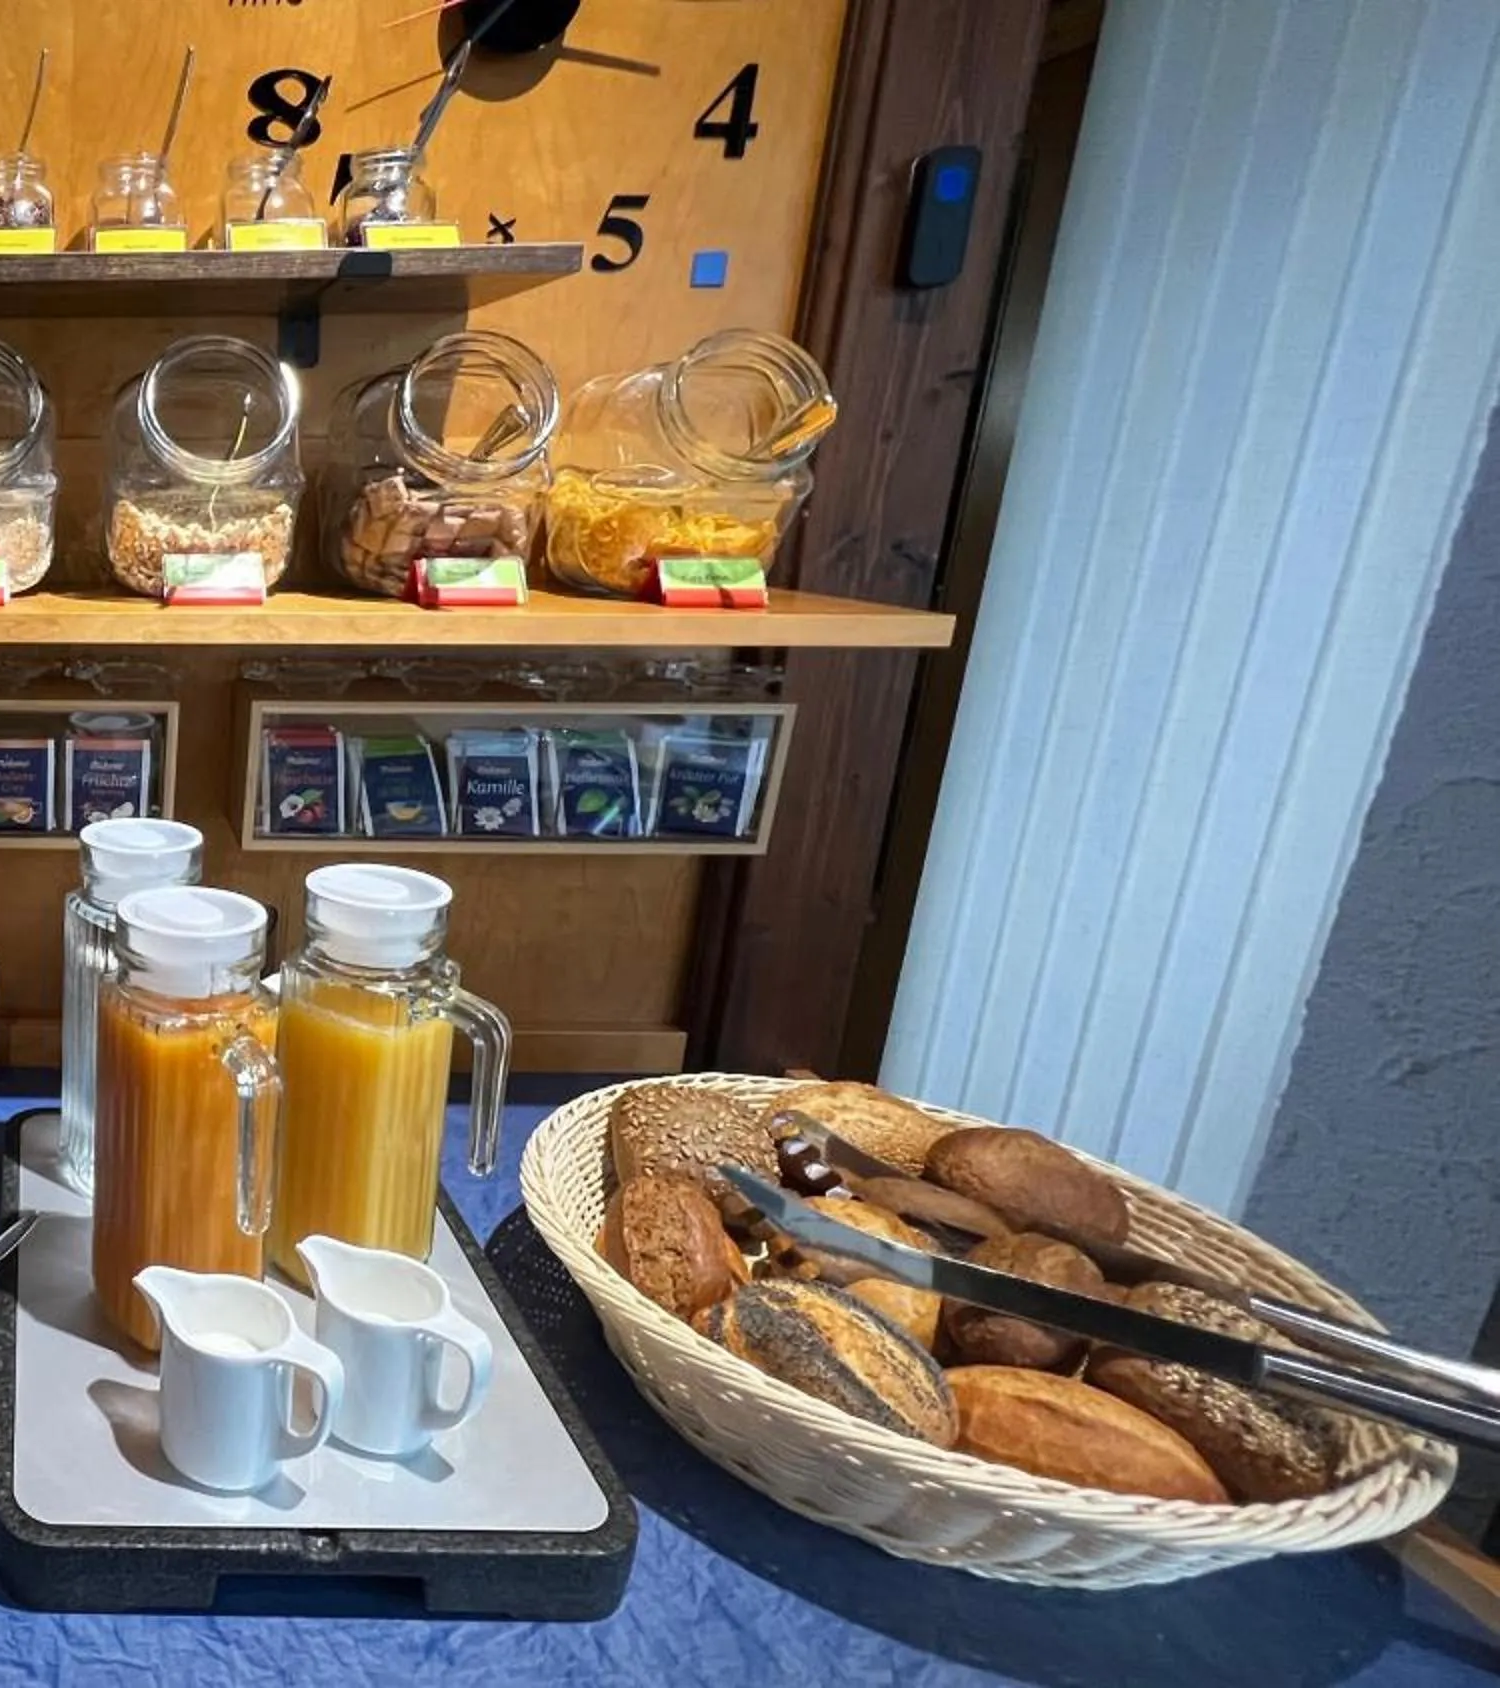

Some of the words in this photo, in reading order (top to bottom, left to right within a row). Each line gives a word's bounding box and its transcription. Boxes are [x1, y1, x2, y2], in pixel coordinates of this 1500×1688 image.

[246, 67, 324, 148] 8
[692, 63, 760, 160] 4
[589, 194, 651, 272] 5
[466, 779, 525, 796] Kamille
